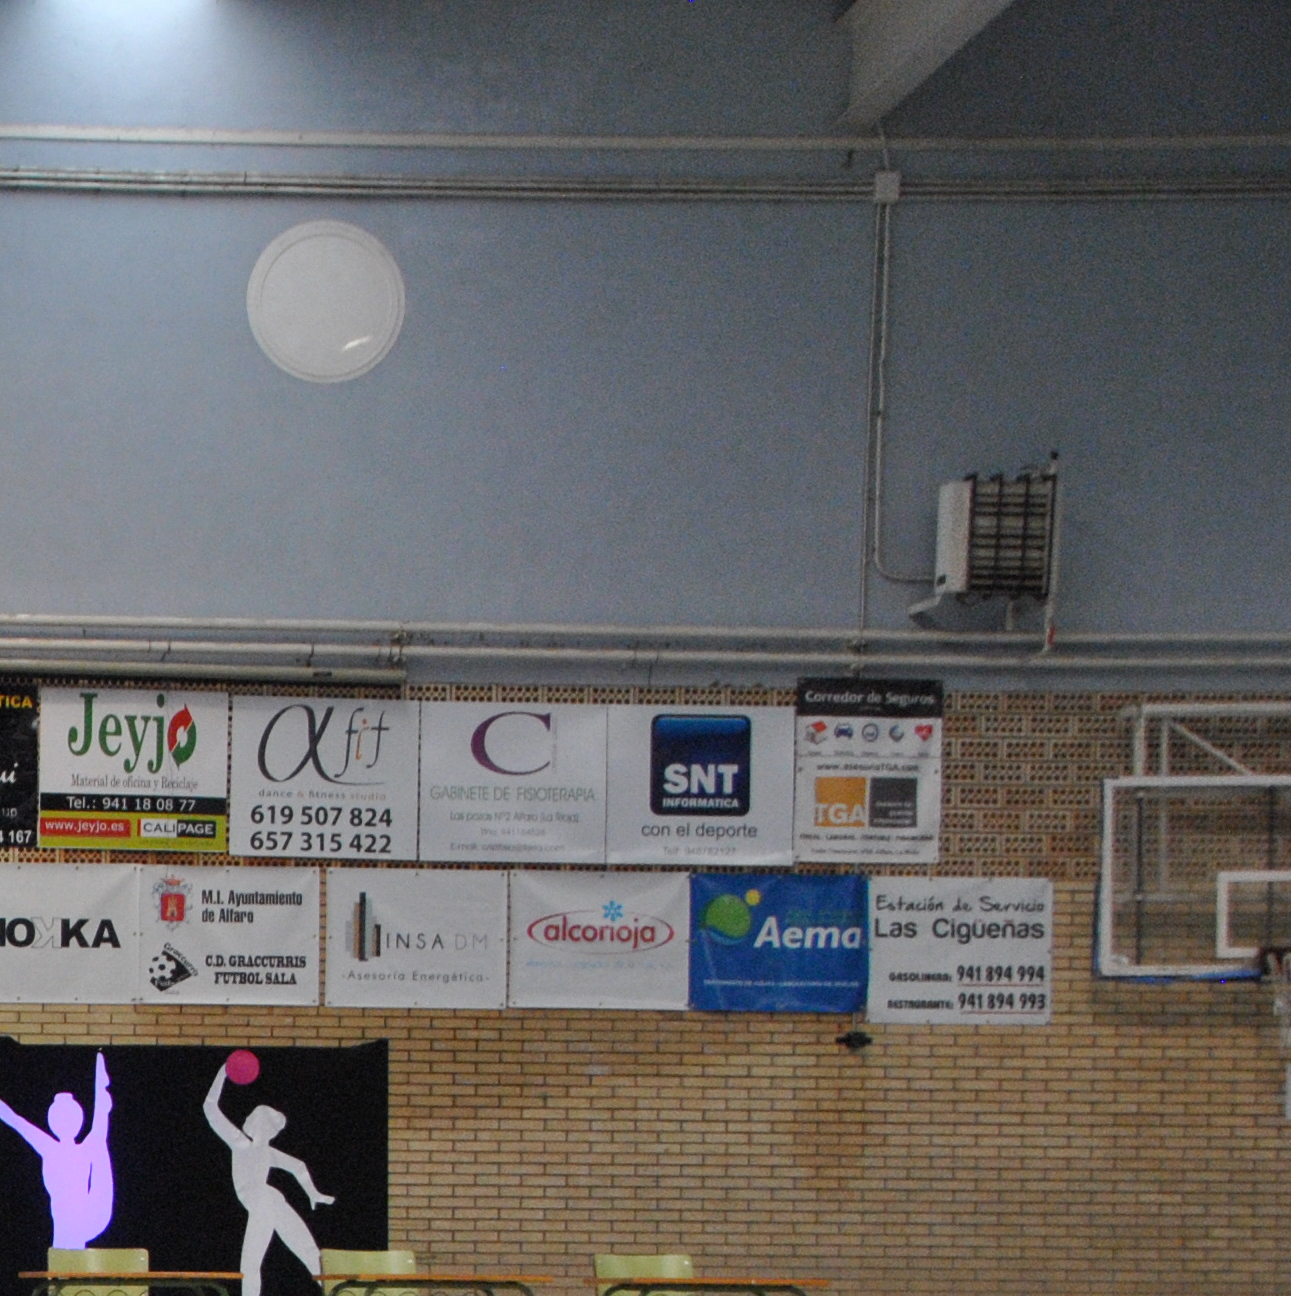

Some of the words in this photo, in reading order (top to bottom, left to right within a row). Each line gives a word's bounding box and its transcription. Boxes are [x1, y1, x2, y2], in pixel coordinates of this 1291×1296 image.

[804, 690, 864, 704] Corredor
[867, 691, 882, 704] de
[885, 691, 935, 707] Seguros
[67, 692, 197, 775] Jeyjo
[470, 711, 552, 776] C
[70, 773, 108, 789] Material
[122, 775, 151, 789] oficina
[663, 763, 739, 795] SNT
[258, 788, 294, 798] dance
[429, 786, 490, 801] GABINETE
[494, 786, 511, 801] DE
[516, 786, 596, 802] FISIOTERAPIA
[102, 797, 128, 811] 941
[135, 798, 151, 811] 18
[156, 798, 174, 812] 08
[177, 799, 196, 812] 77
[814, 802, 868, 825] TGA
[250, 804, 294, 825] 619
[300, 806, 343, 827] 507
[349, 807, 393, 828] 824
[44, 819, 125, 833] www.jeyjo.es
[641, 825, 671, 837] con
[675, 823, 690, 837] el
[695, 823, 758, 841] deporte
[8, 829, 33, 843] 167
[250, 830, 294, 851] 657
[300, 831, 343, 852] 315
[349, 833, 393, 854] 422
[227, 890, 303, 908] Ayuntamiento
[875, 894, 944, 912] Estación
[952, 897, 972, 912] de
[979, 895, 1045, 913] Servicio
[201, 908, 215, 923] de
[218, 908, 255, 924] Alfaro
[753, 915, 863, 949] Aema
[874, 918, 918, 939] Las
[931, 918, 1046, 945] Cigüeñas
[385, 932, 445, 950] INSA
[454, 933, 489, 950] DM
[205, 954, 227, 968] C.D.
[228, 955, 307, 969] GRACCURRIS
[214, 971, 264, 985] FUTBOL
[265, 972, 297, 985] SALA
[957, 964, 982, 982] 941
[985, 965, 1013, 982] 894
[1016, 965, 1045, 982] 994
[958, 992, 983, 1010] 941
[987, 993, 1014, 1010] 894
[1019, 993, 1047, 1010] 993
